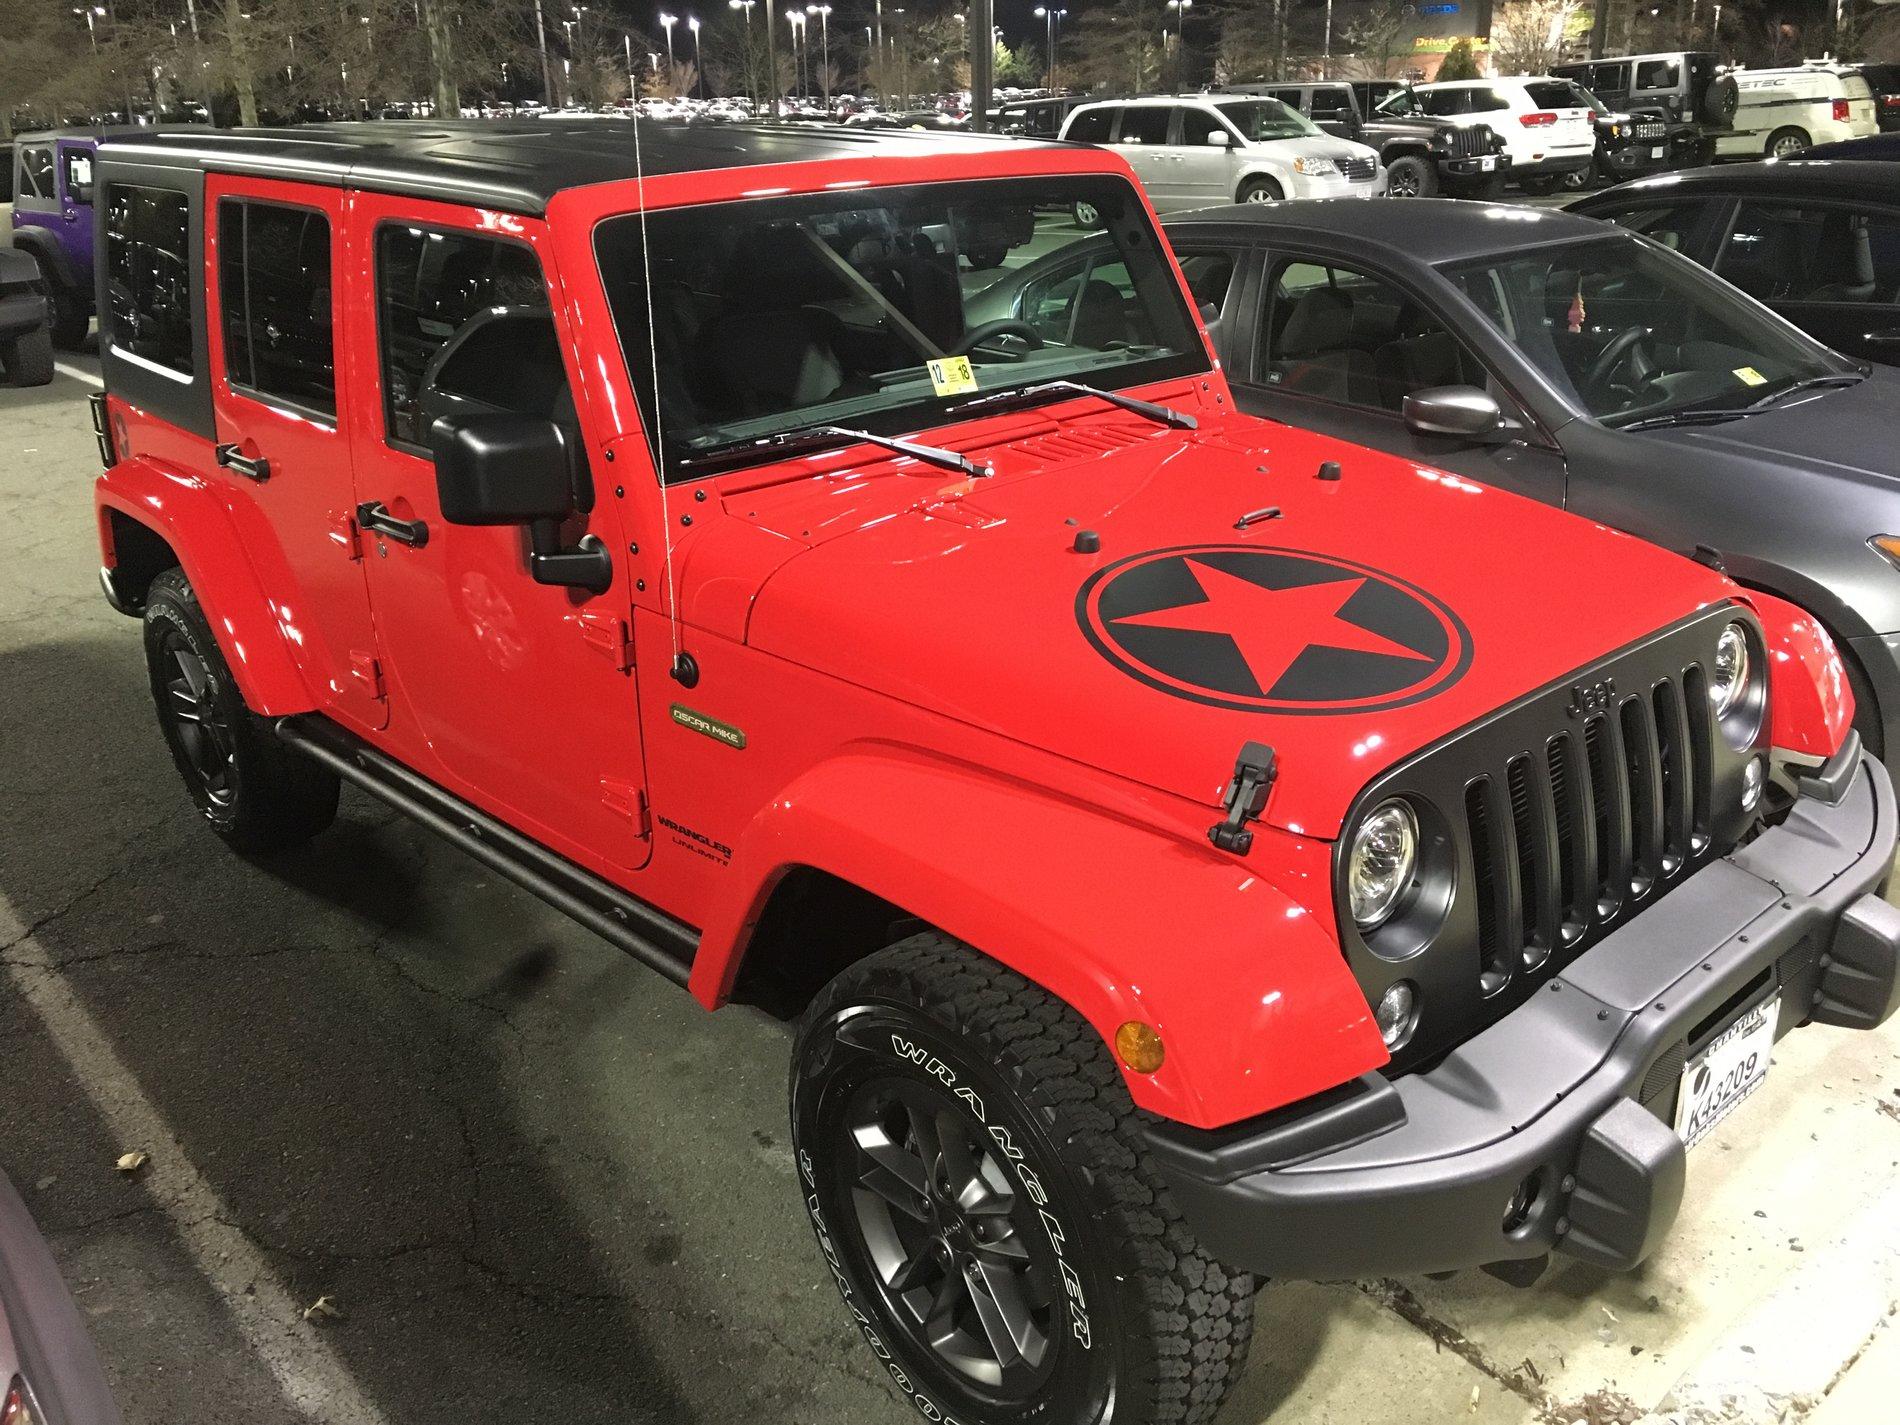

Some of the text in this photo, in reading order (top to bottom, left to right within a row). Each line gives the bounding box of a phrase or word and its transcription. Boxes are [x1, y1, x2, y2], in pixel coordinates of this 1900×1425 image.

[1415, 37, 1445, 46] Drive
[932, 364, 945, 384] 12
[958, 364, 970, 380] 18
[1567, 677, 1616, 718] Jeep
[673, 709, 739, 743] OSCAR MIKE
[657, 814, 733, 859] WRANGLER
[1687, 1052, 1758, 1136] K43209
[891, 1034, 1091, 1350] WRANGLER
[799, 1149, 960, 1425] OODYEAR
